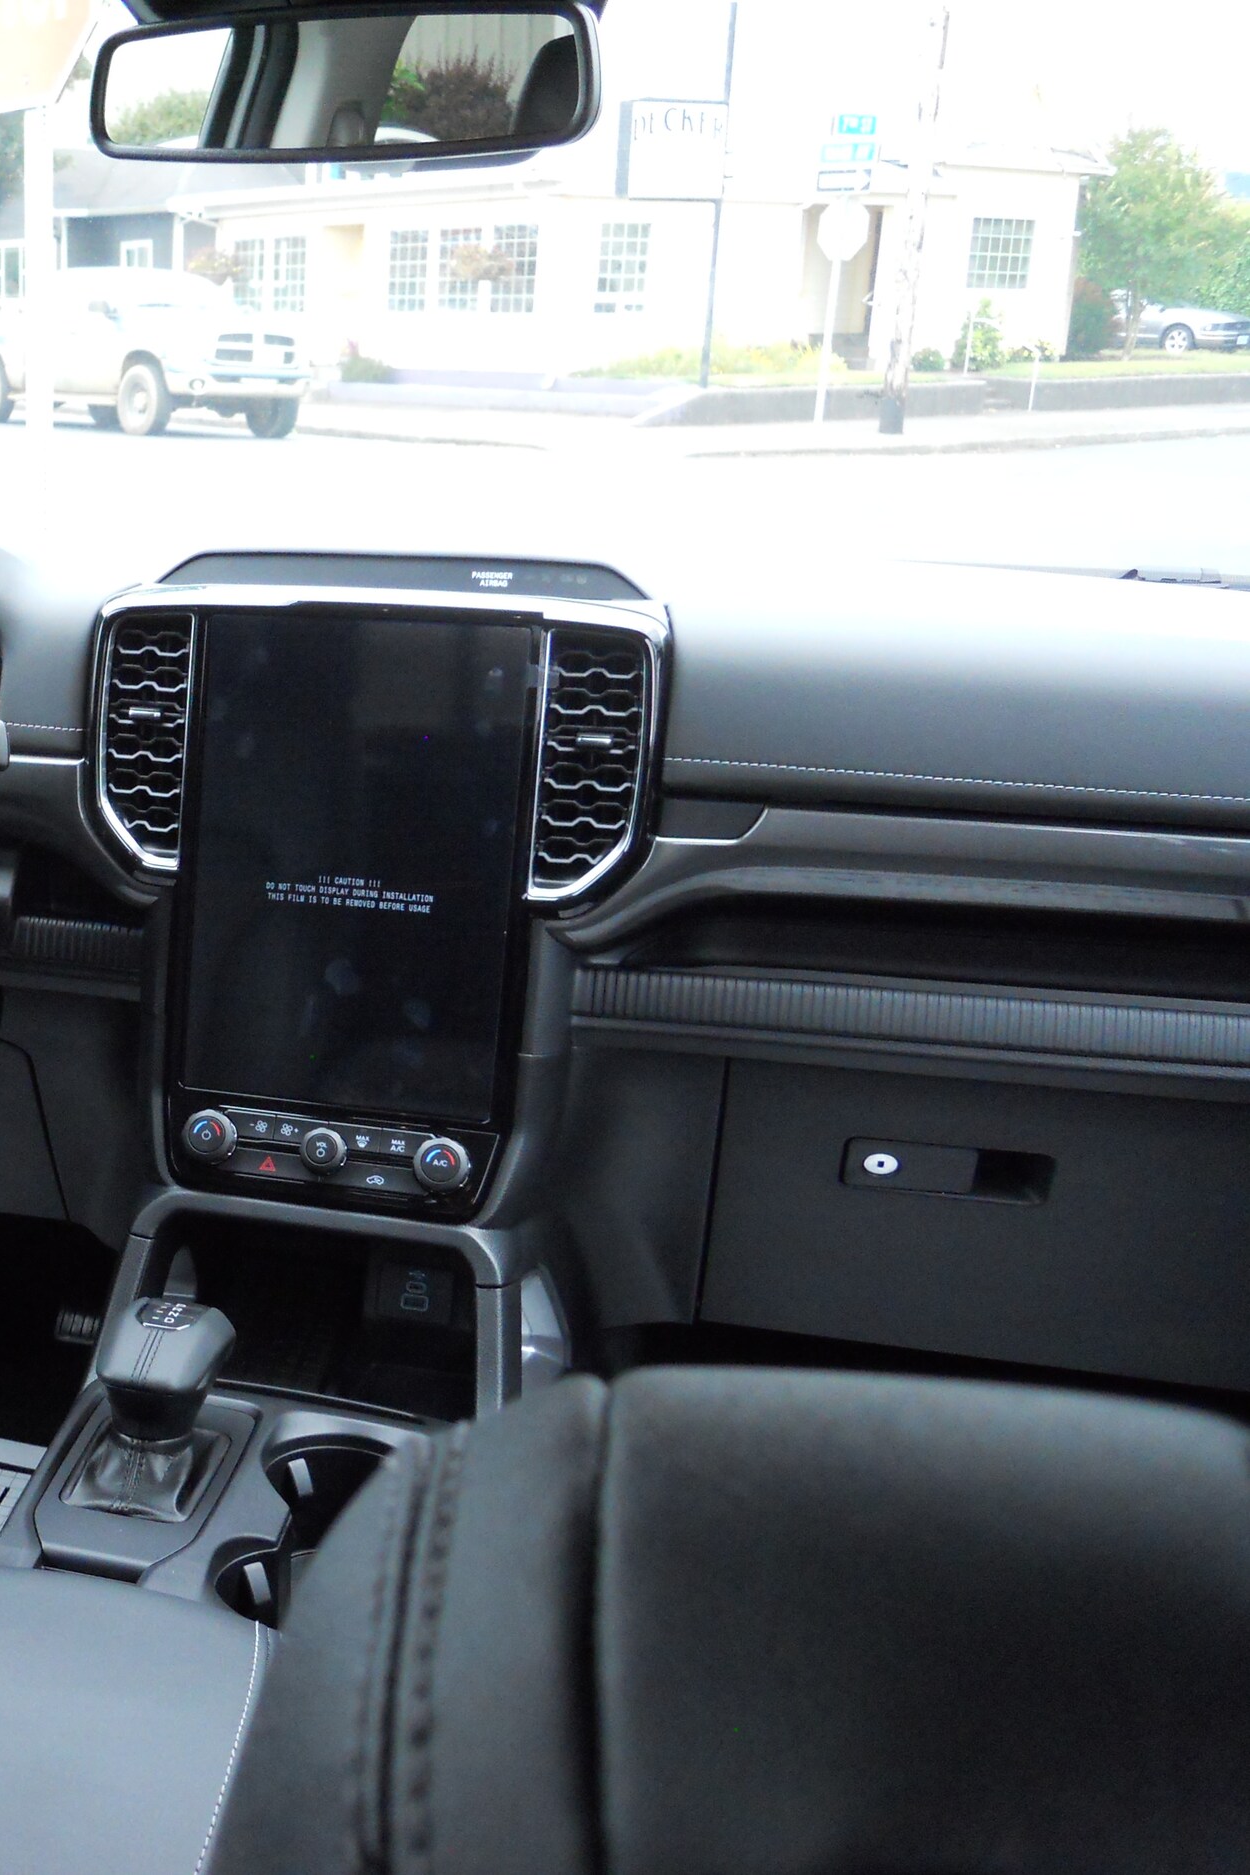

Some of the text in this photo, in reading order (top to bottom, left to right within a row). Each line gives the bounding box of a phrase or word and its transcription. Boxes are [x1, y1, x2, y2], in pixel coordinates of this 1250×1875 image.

[471, 571, 513, 580] PASSENGER
[479, 579, 508, 588] AIRBAG
[334, 876, 365, 887] CAUTION
[265, 881, 434, 903] DO NOT TOUCH DISPLAY DURING INSTALLATION
[268, 892, 431, 914] THIS FILM IS TO BE REMOVED BEFORE USAGE
[316, 1141, 328, 1149] VOL
[390, 1145, 405, 1153] A/C
[432, 1159, 448, 1168] A/C
